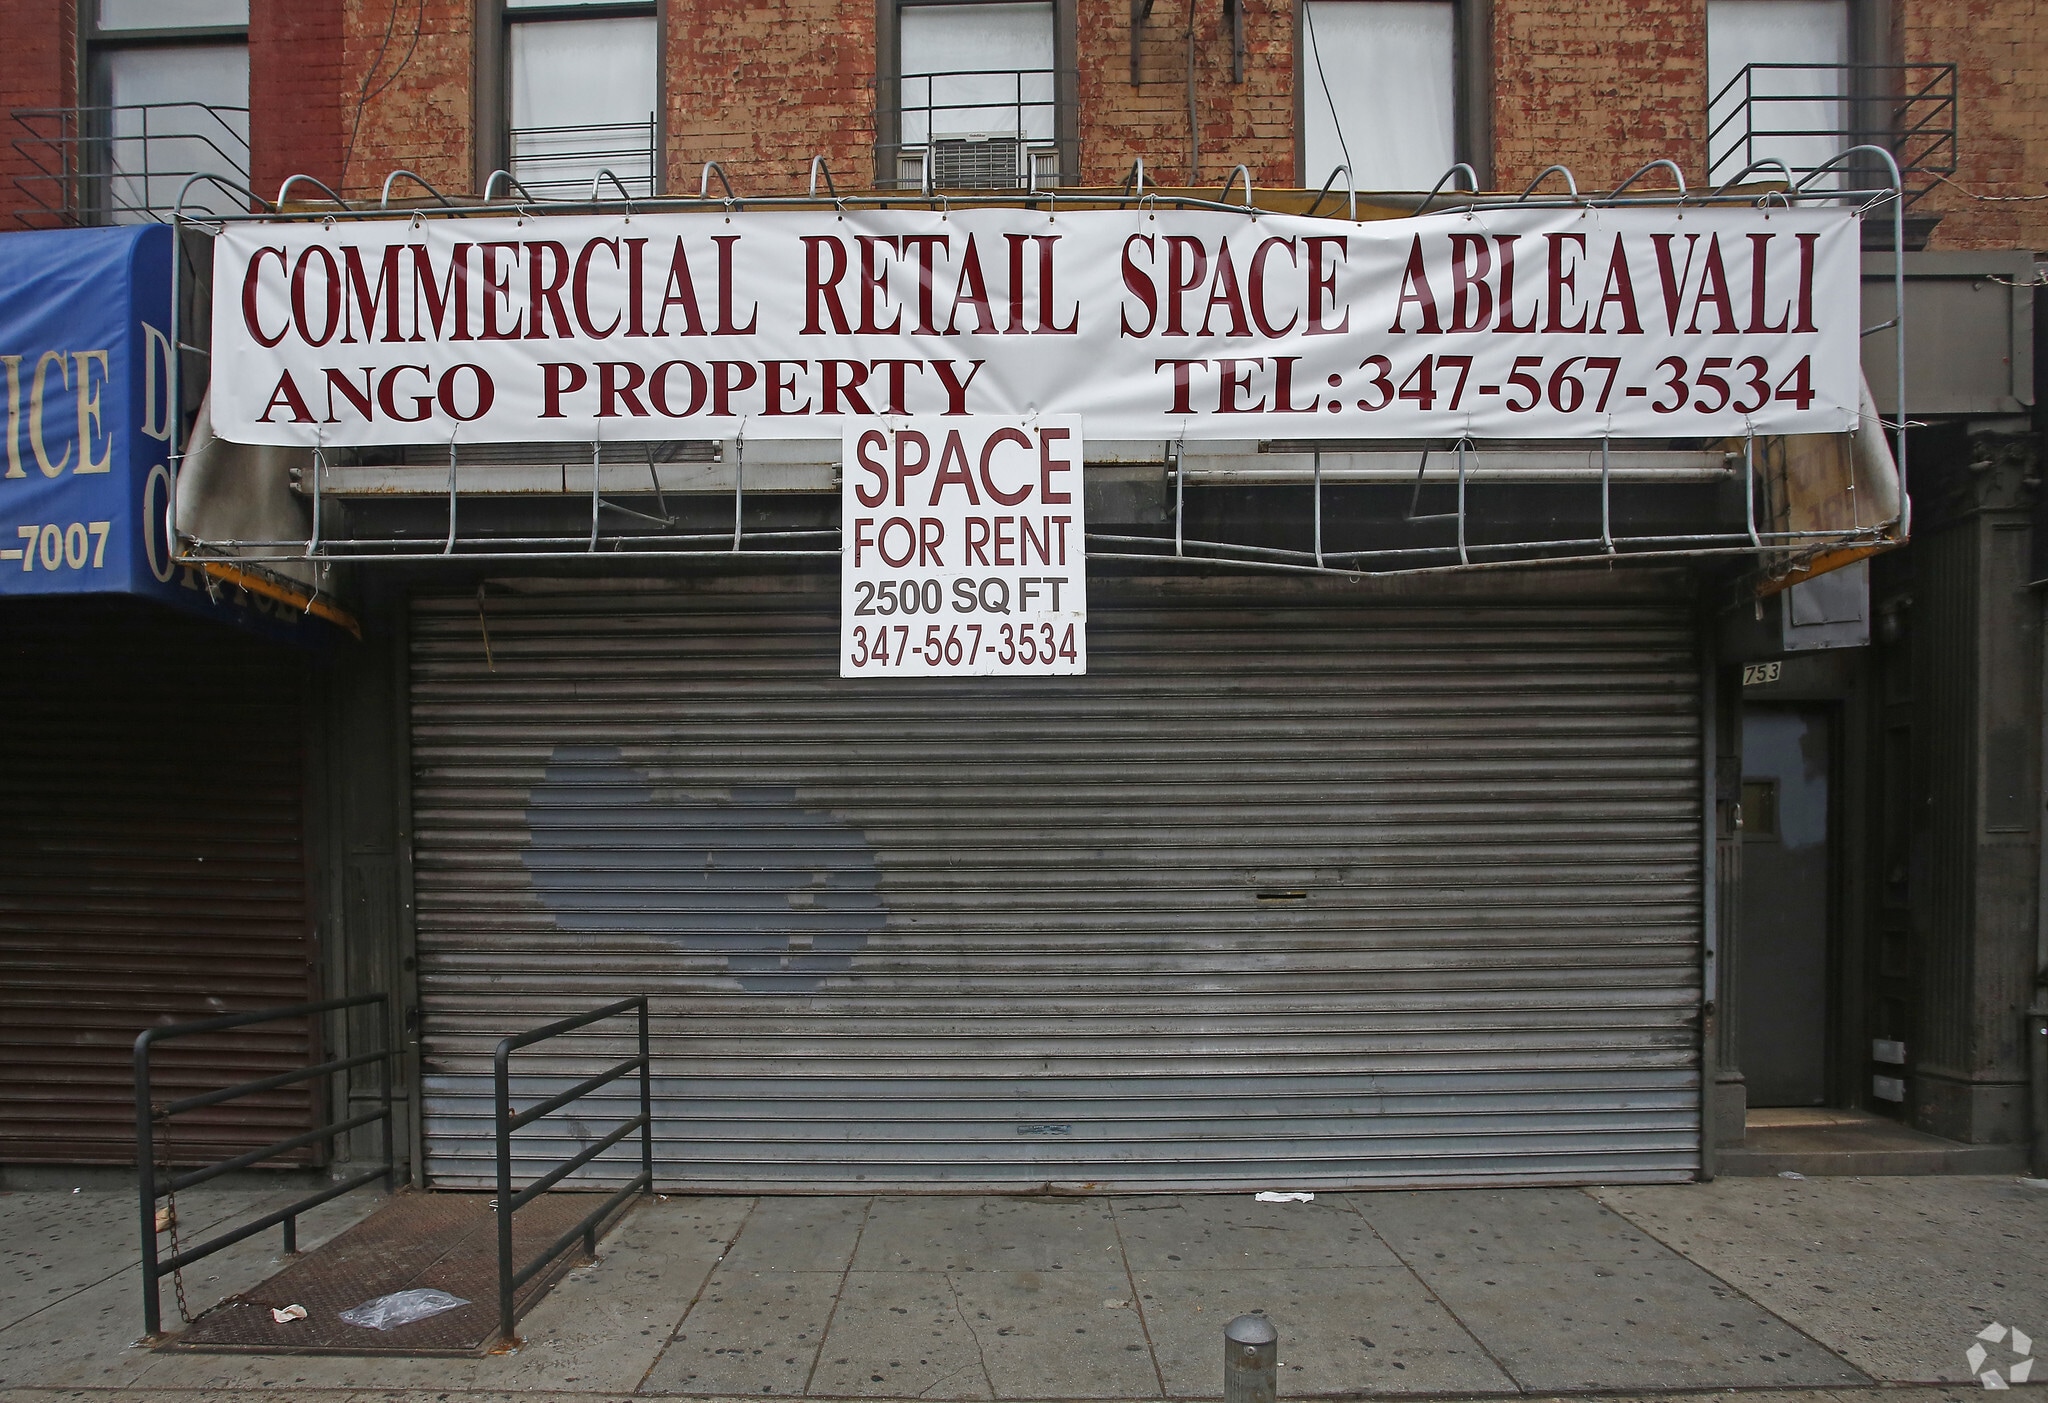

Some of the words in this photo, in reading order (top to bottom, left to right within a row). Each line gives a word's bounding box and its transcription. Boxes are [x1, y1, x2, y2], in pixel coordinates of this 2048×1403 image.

[241, 236, 758, 348] COMMERCIAL
[799, 233, 1080, 336] RETAIL
[1120, 233, 1349, 338] SPACE
[1387, 232, 1821, 336] ABLEAVALI
[255, 364, 495, 424] ANGO
[537, 359, 986, 418] PROPERTY
[854, 426, 1072, 508] SPACE
[854, 516, 945, 568] FOR
[964, 515, 1072, 567] RENT
[853, 578, 943, 616] 2500
[850, 622, 1078, 668] 347-567-3534
[1745, 663, 1779, 684] 753
